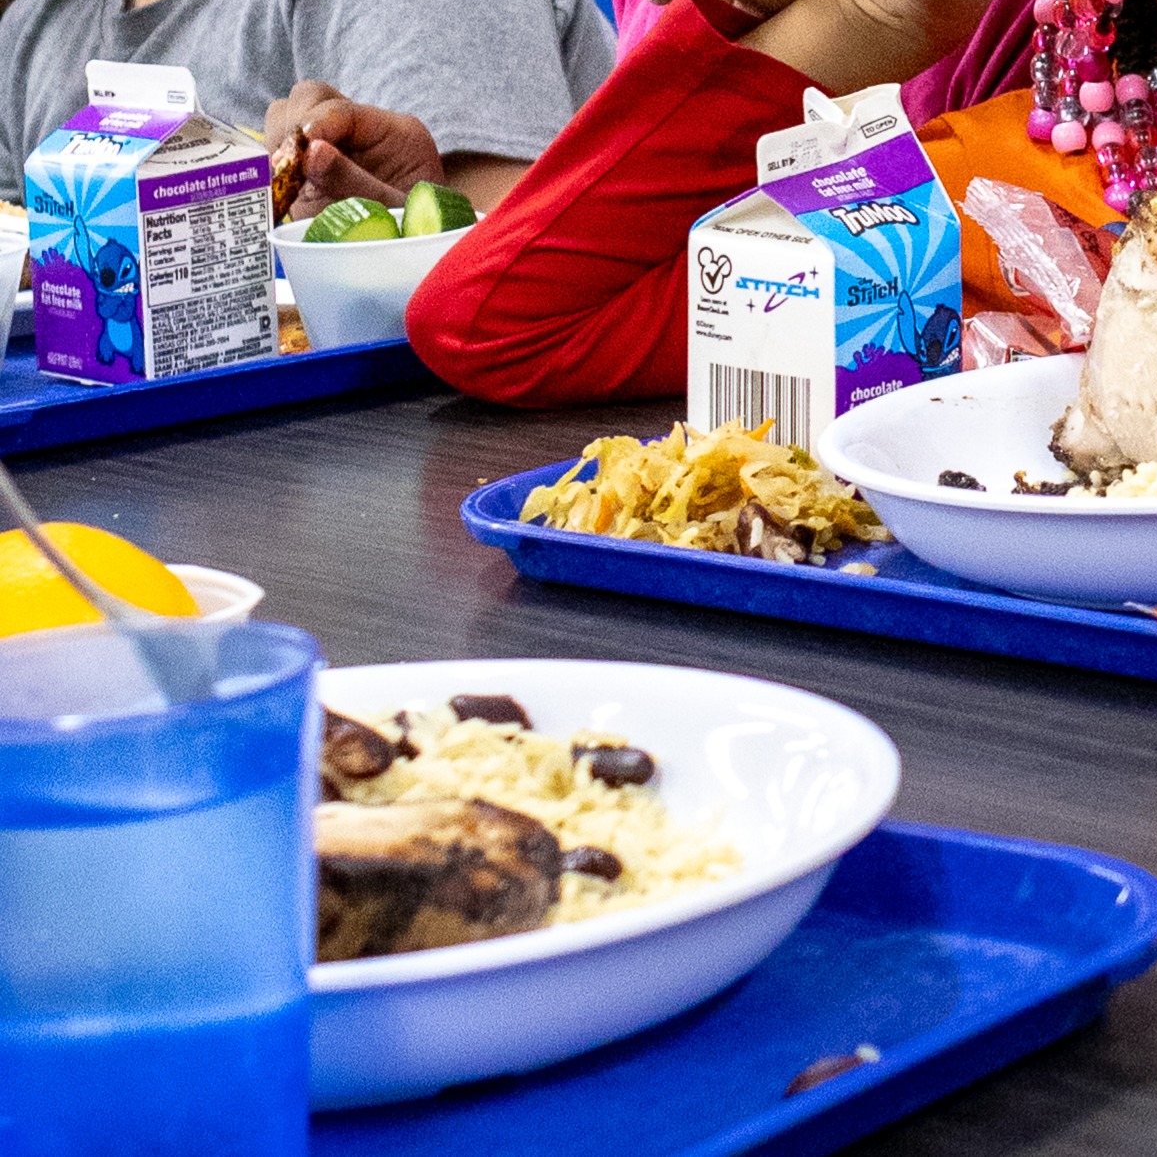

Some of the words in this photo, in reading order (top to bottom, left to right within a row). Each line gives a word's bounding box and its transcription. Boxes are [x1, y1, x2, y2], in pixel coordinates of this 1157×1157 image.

[876, 119, 894, 131] OPEN
[153, 179, 206, 200] chocolate
[207, 175, 220, 189] fat
[221, 172, 238, 186] free
[238, 167, 259, 182] milk
[811, 166, 868, 189] chocolate
[852, 176, 877, 190] milk
[146, 212, 187, 229] Nutrition
[830, 201, 920, 237] TruMoo
[146, 227, 173, 243] Facts
[760, 231, 792, 242] OTHER
[791, 235, 814, 245] SIDE
[174, 266, 189, 281] 110
[40, 280, 82, 299] chocolate
[850, 379, 903, 402] chocolate
